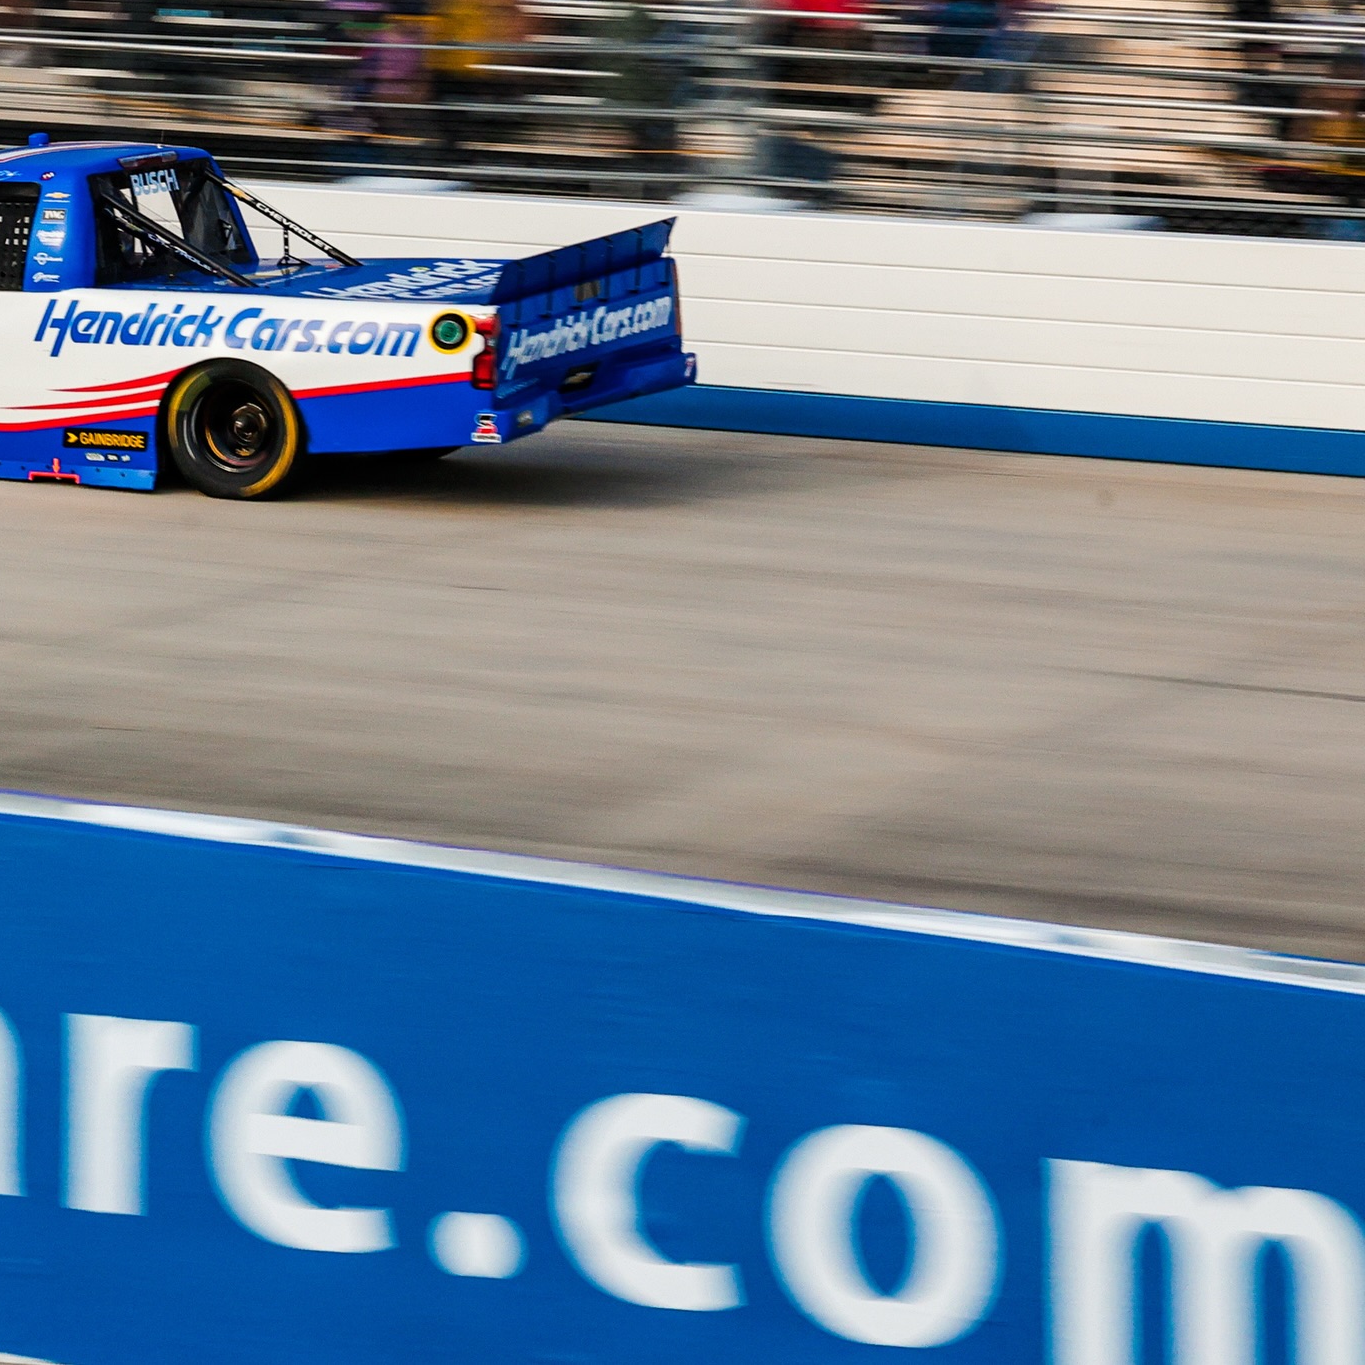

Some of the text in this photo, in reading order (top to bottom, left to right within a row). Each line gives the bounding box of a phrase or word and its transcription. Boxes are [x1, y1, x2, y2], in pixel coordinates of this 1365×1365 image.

[130, 168, 180, 196] BUSCH
[256, 202, 333, 251] CHEVROLET
[79, 431, 145, 449] GAINBRIDGE
